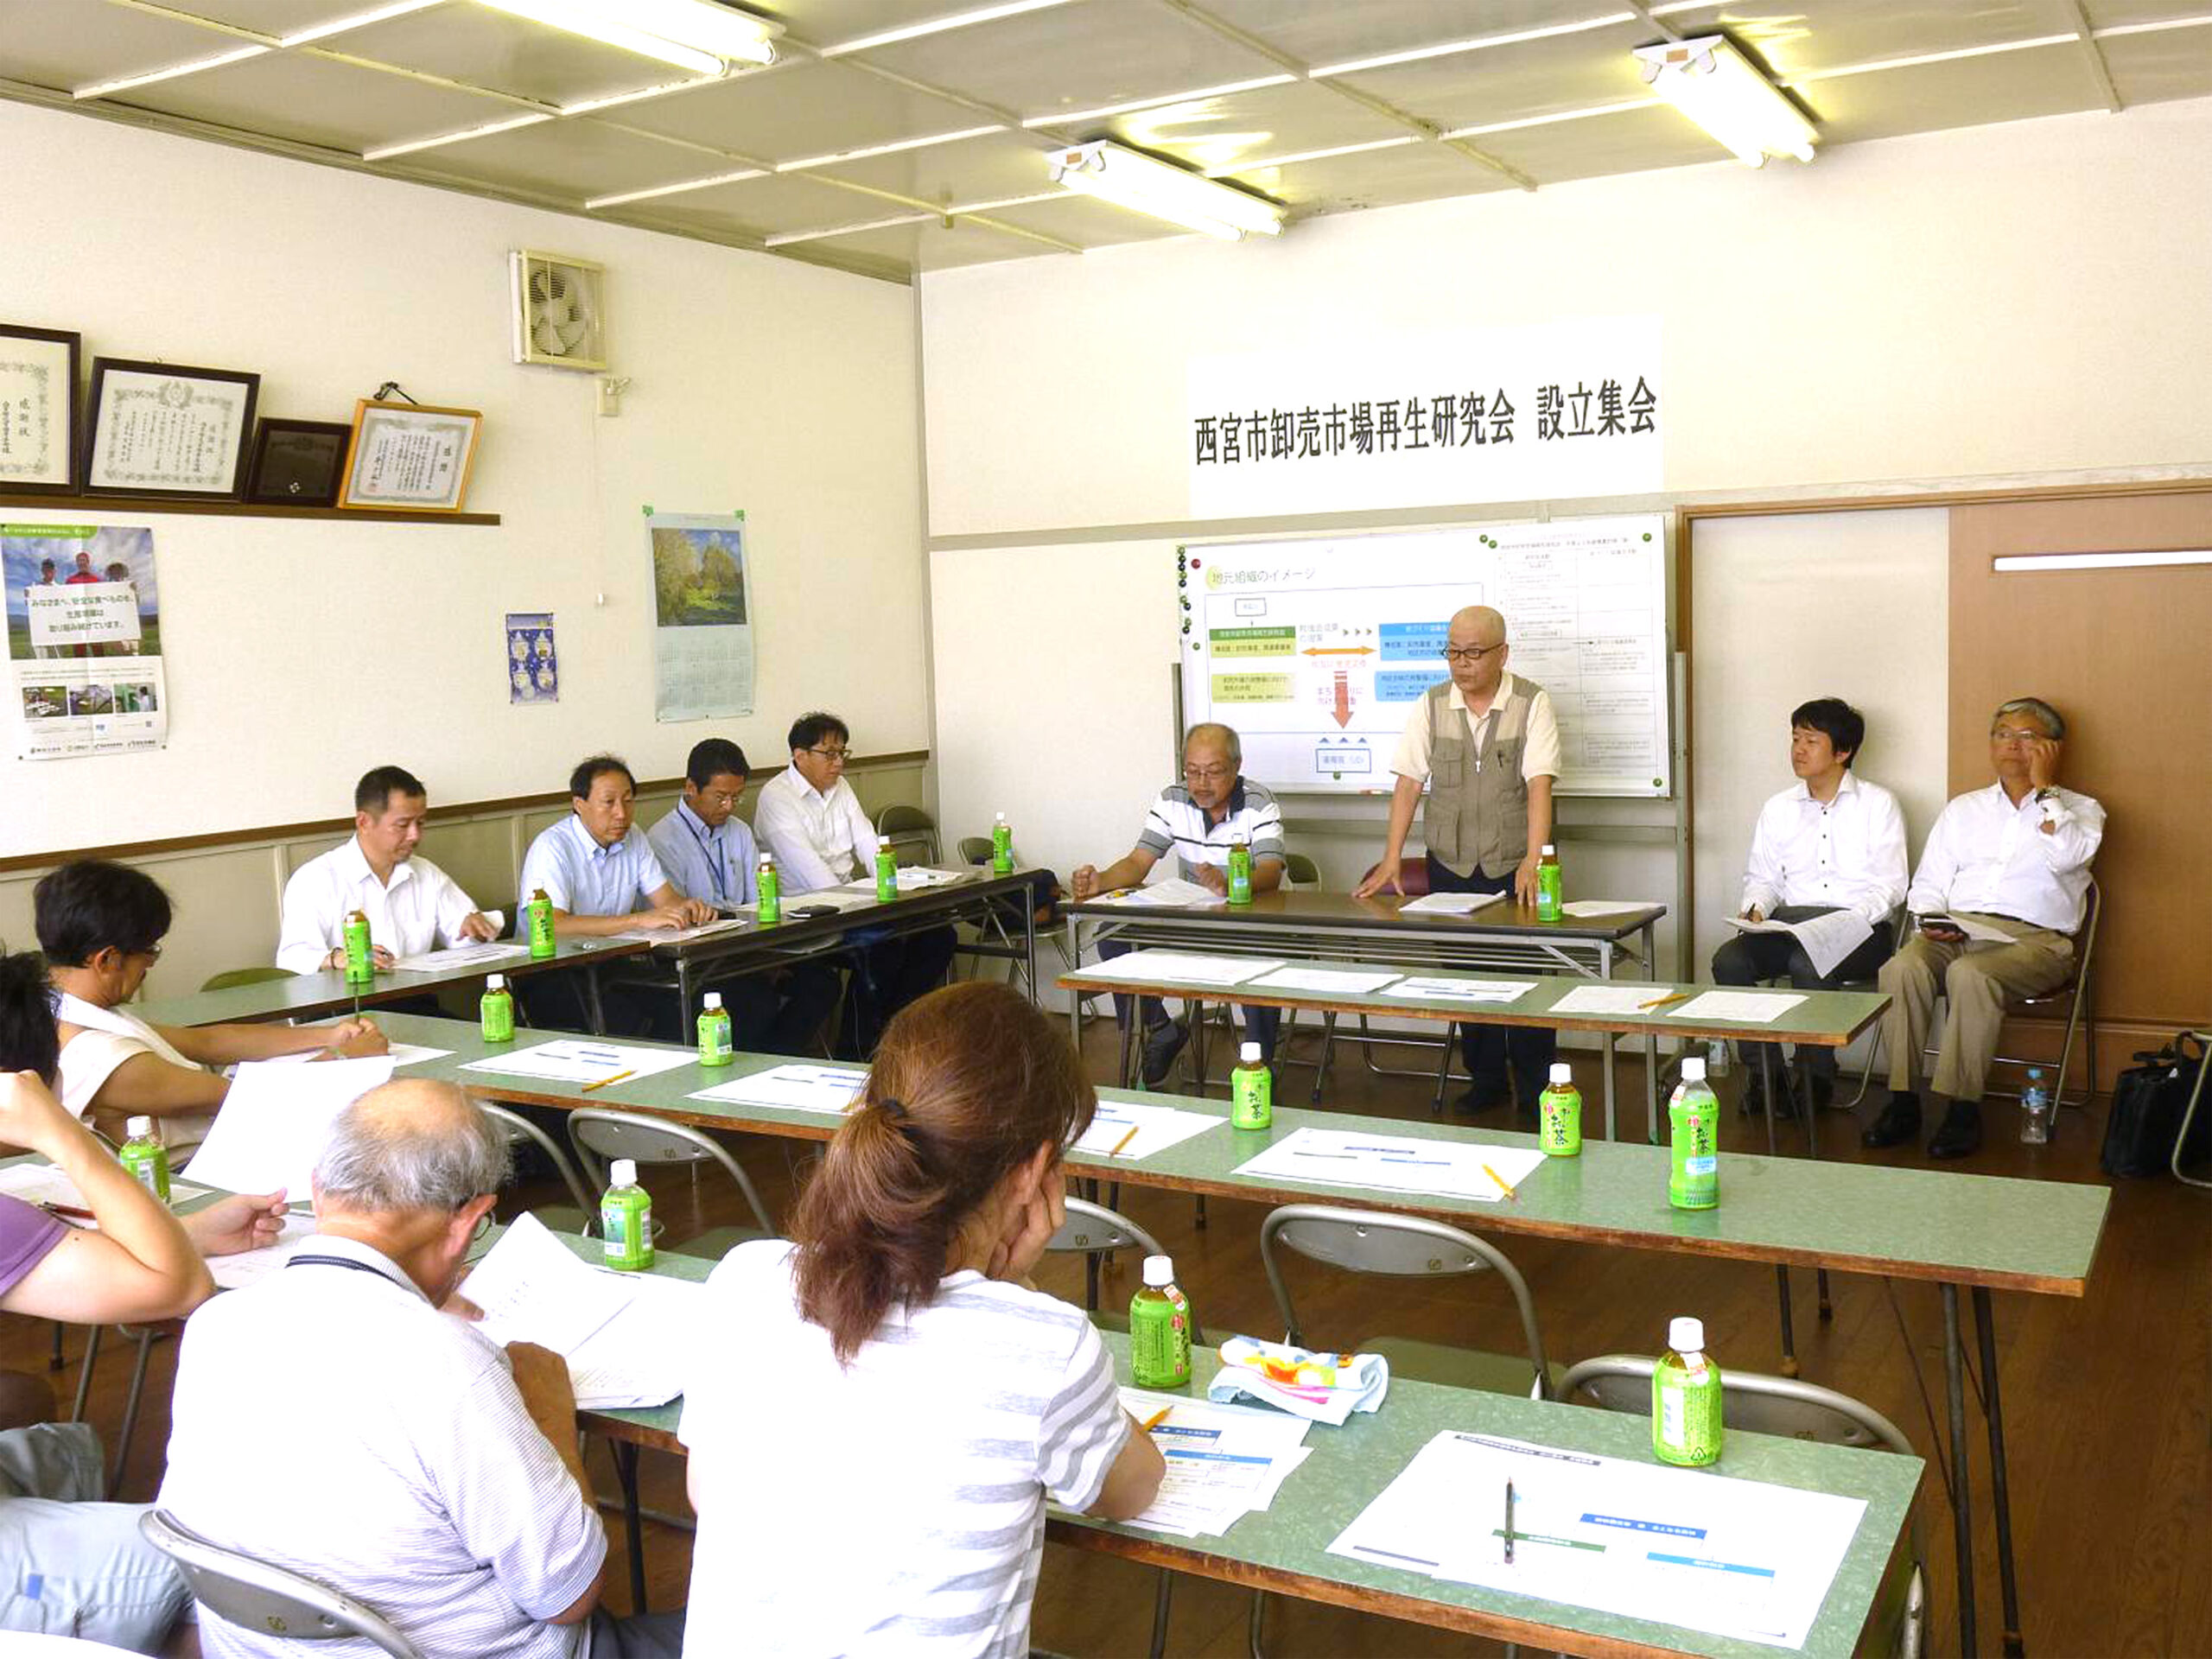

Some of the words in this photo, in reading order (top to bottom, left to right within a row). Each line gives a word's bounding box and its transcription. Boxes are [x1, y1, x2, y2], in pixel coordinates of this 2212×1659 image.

[1195, 388, 1516, 466] 西宮市卸売市場再生研究会
[1536, 375, 1657, 442] 設立集会
